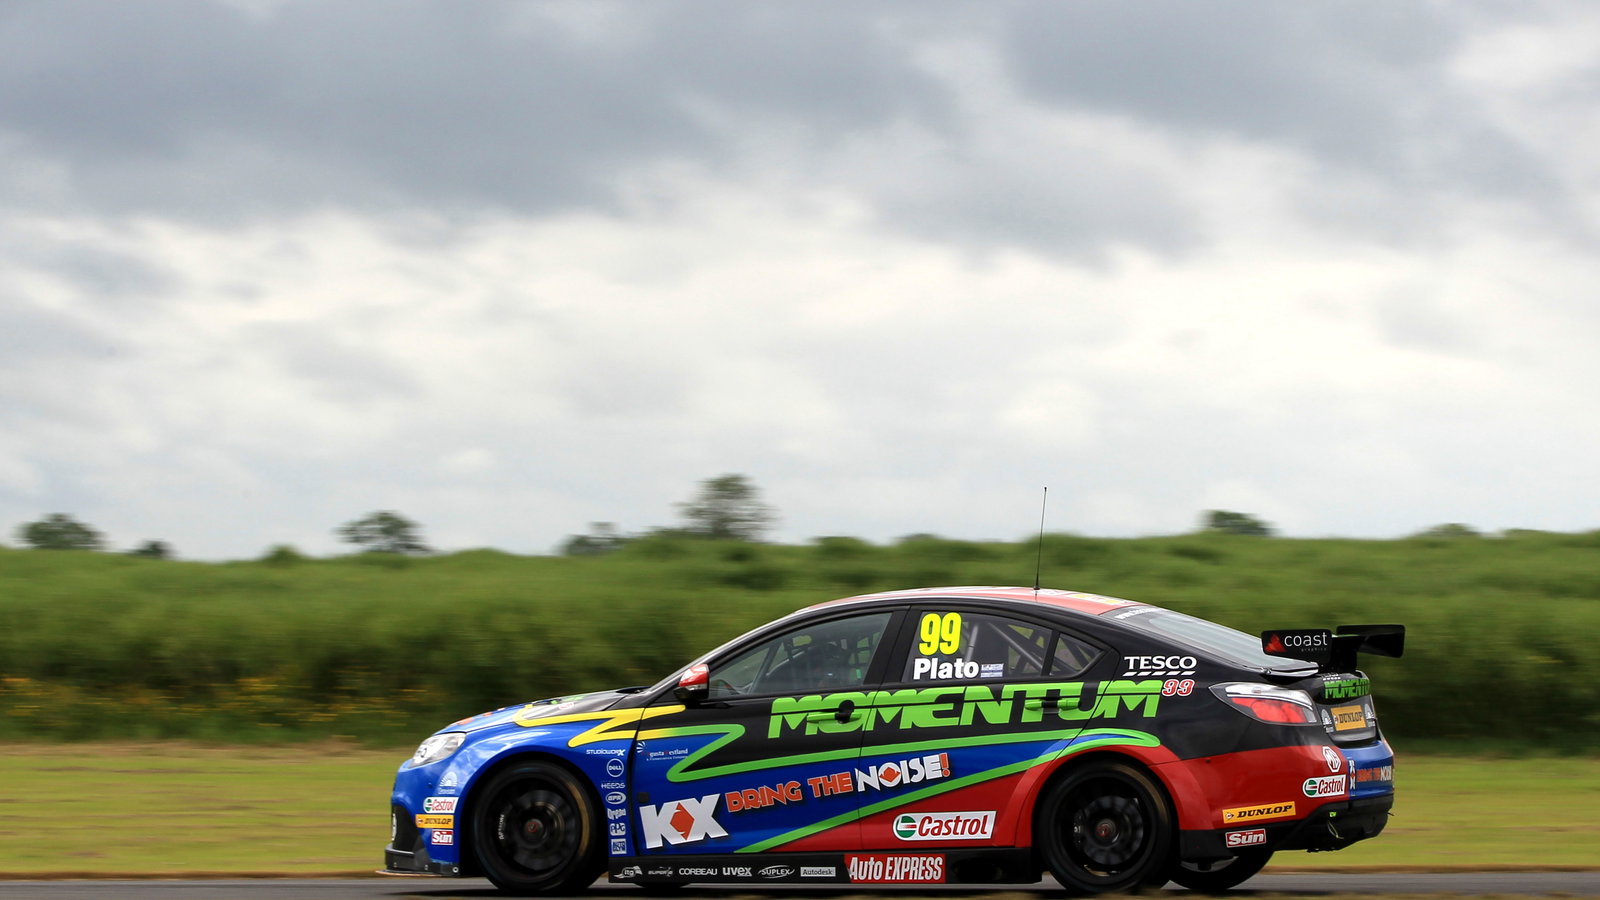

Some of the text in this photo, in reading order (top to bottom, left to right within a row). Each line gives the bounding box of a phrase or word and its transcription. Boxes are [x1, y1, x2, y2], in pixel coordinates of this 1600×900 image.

[918, 612, 962, 655] 99
[1284, 632, 1328, 647] coast
[913, 657, 980, 680] Plato
[1124, 656, 1197, 670] TESCO
[767, 680, 1196, 739] MOMENTUM 99
[1338, 711, 1363, 724] DUNLOP
[1317, 776, 1345, 795] Castrol
[431, 799, 456, 811] Castrol
[639, 753, 951, 849] KX BRING THE NOISE!
[1237, 805, 1293, 818] DUNLOP
[918, 814, 988, 838] Castrol
[432, 831, 453, 843] Sun
[1228, 833, 1265, 845] Sun
[679, 868, 717, 876] CORBEAU
[722, 867, 752, 876] uvex
[761, 868, 790, 876] SUPLEX
[849, 856, 943, 880] Auto EXPRESS
